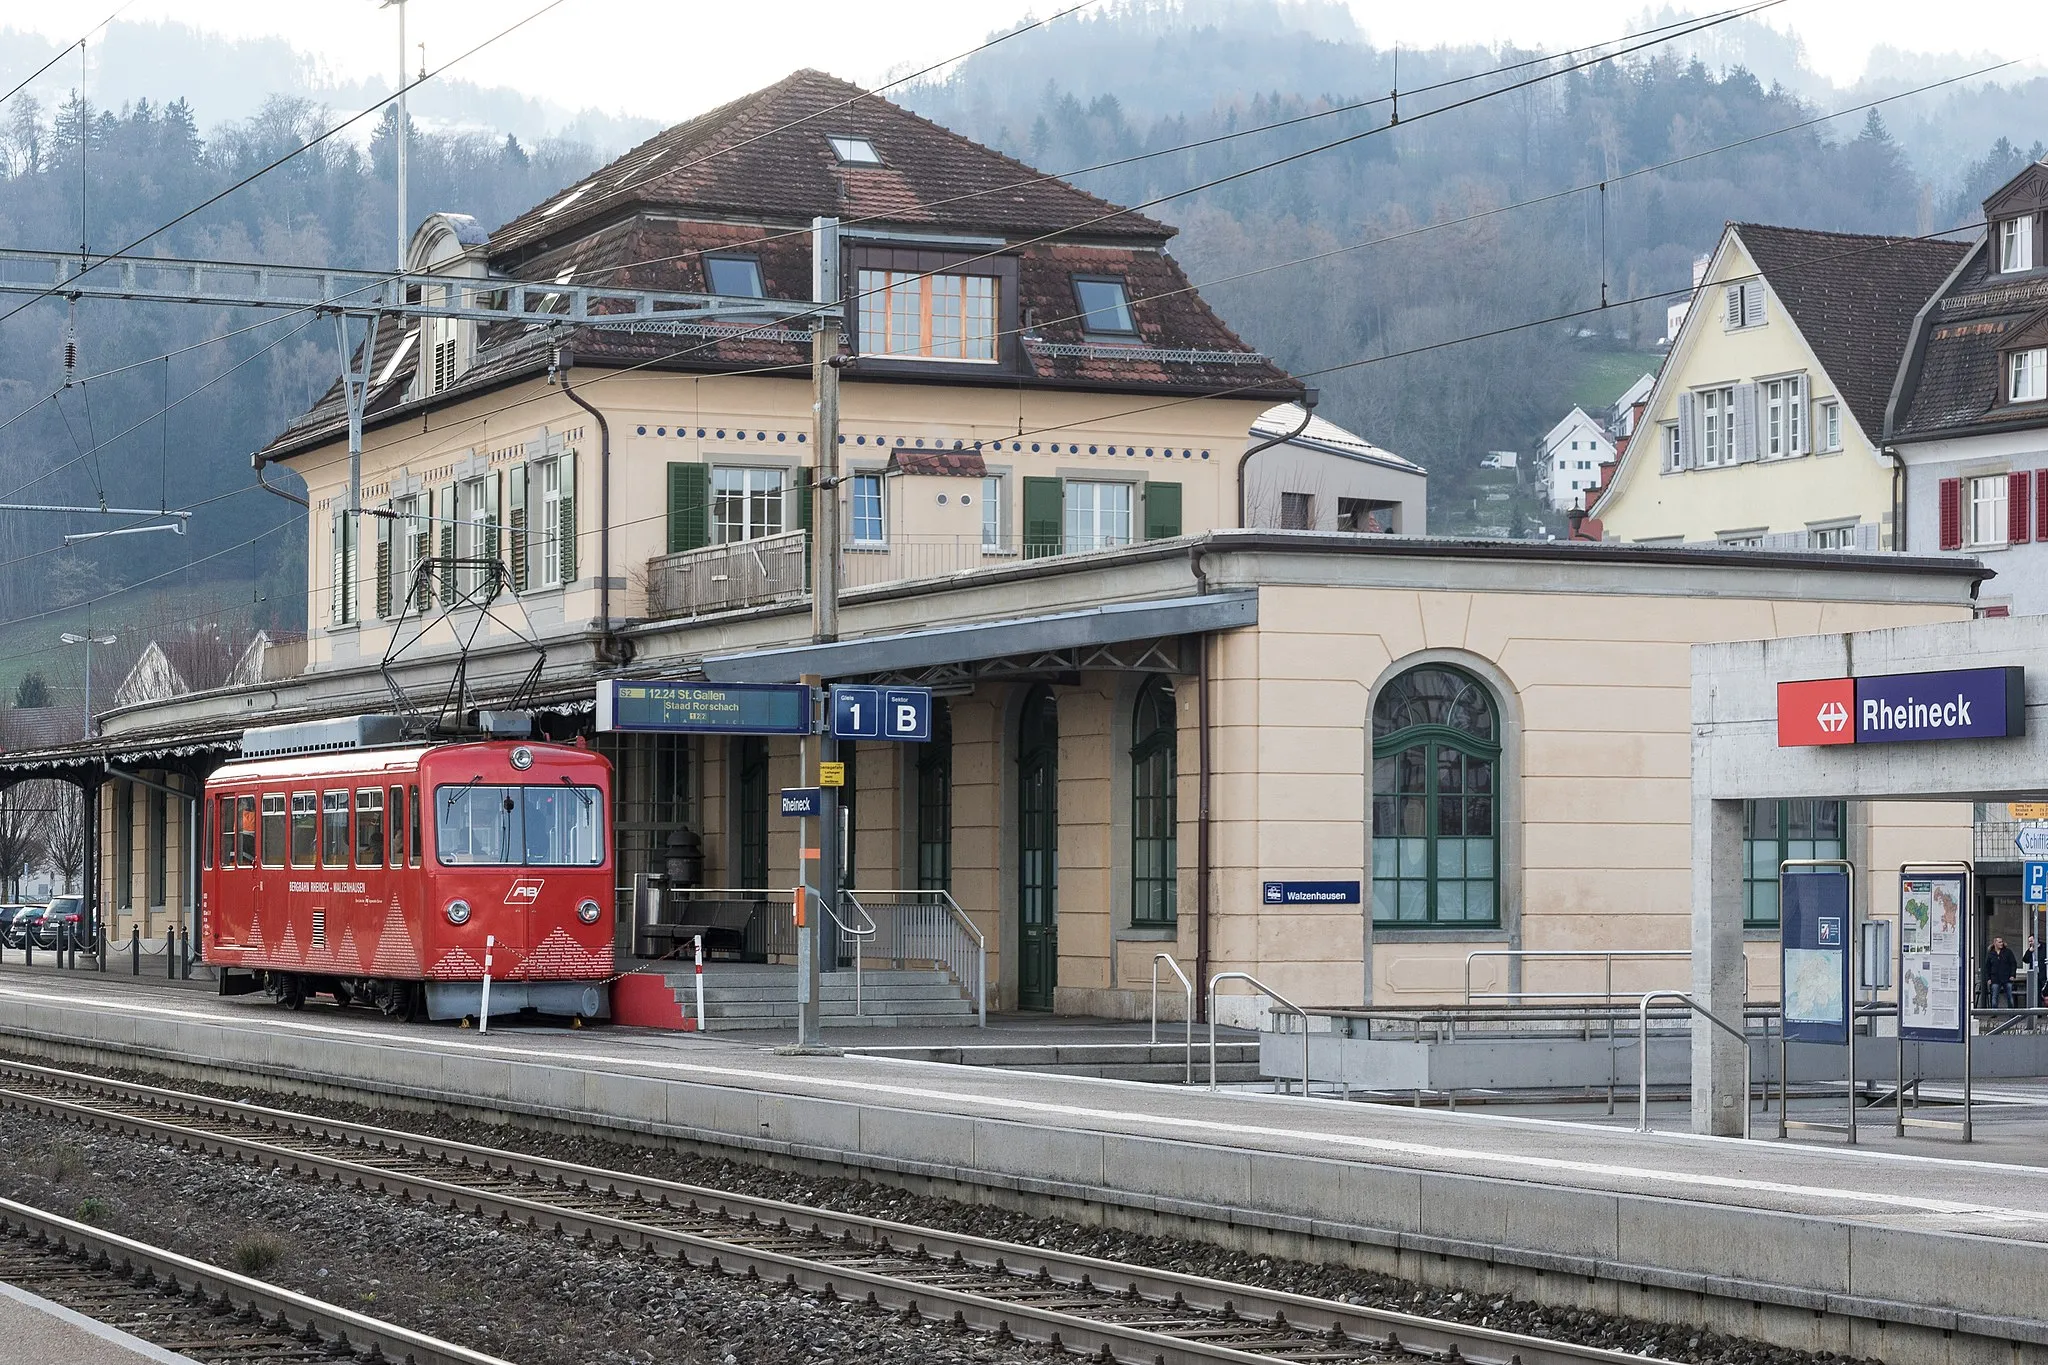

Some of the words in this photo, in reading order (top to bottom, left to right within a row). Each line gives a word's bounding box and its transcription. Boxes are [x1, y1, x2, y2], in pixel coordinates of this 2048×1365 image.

[620, 689, 632, 697] S2
[648, 688, 675, 699] 12.24
[693, 689, 726, 701] Gallen
[665, 701, 691, 710] Staad
[692, 702, 740, 711] Rorschach
[1863, 693, 1972, 731] Rheineck
[850, 703, 861, 731] 1
[897, 705, 917, 732] B
[782, 796, 811, 812] Rheineck
[2032, 865, 2043, 885] P
[512, 886, 538, 897] AB
[1287, 891, 1346, 901] Walzenhausen
